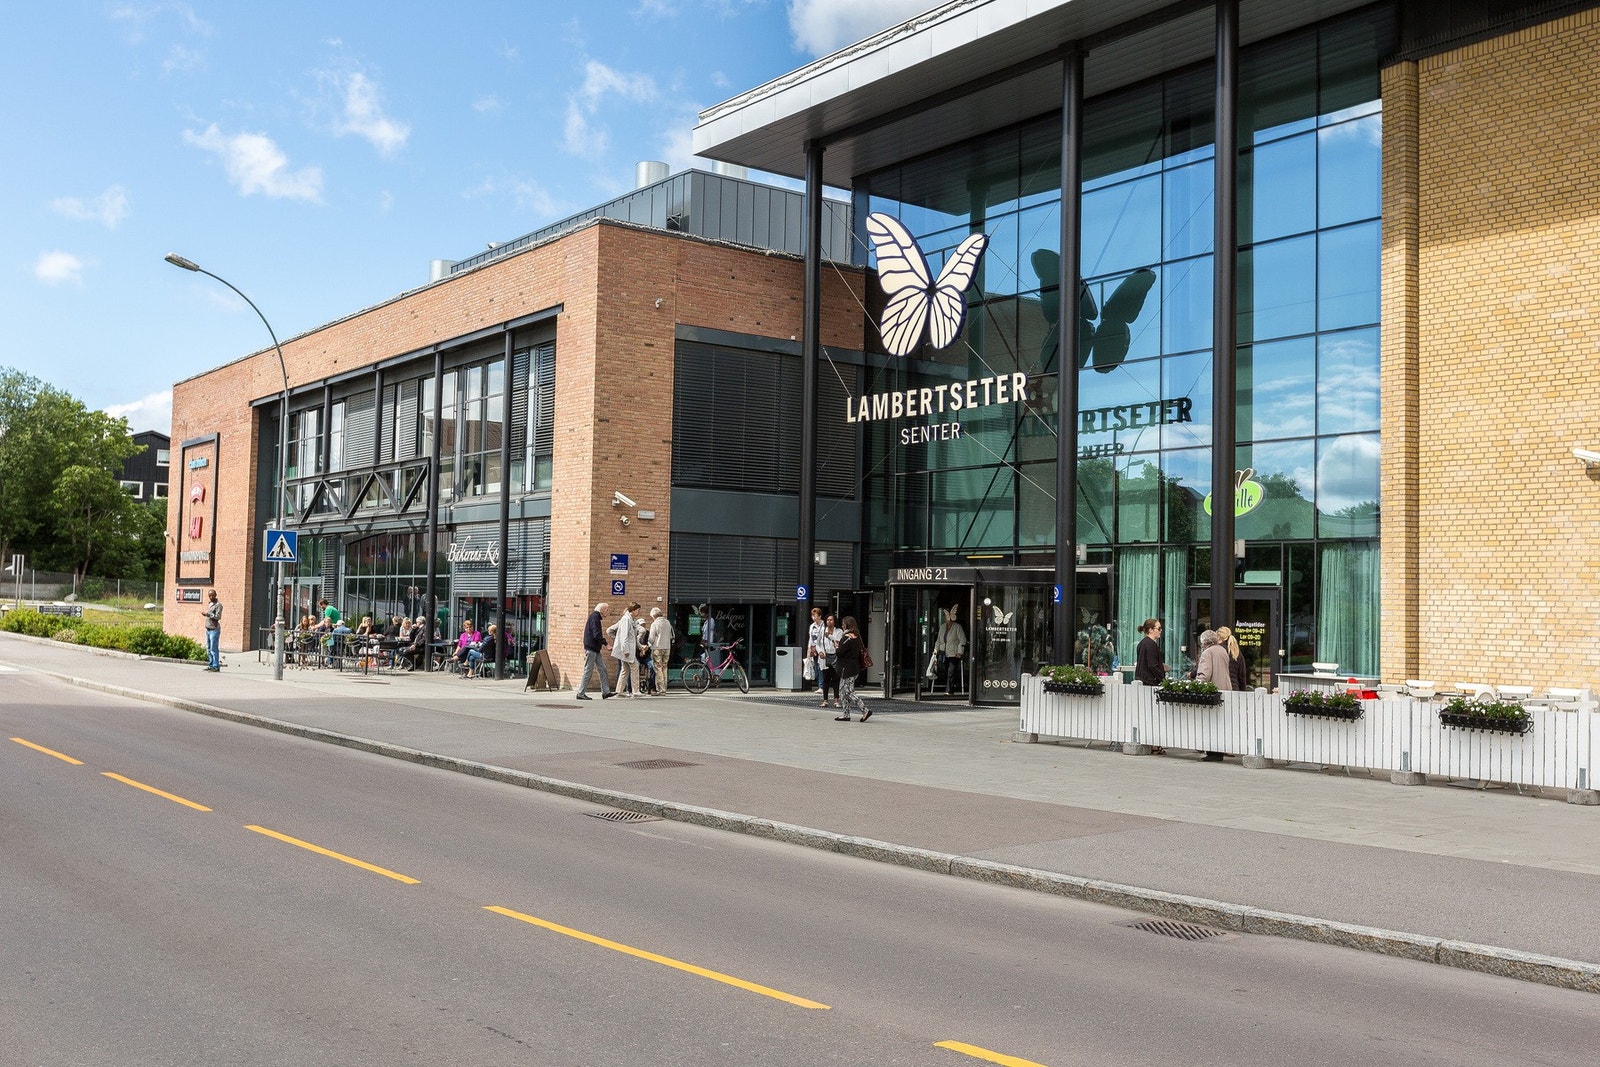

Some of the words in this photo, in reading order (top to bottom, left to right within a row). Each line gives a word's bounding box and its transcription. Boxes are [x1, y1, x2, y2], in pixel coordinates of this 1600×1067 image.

[846, 372, 1028, 424] LAMBERTSETER
[901, 422, 961, 446] SENTER
[897, 568, 932, 580] INNGANG
[935, 568, 948, 580] 21
[1235, 620, 1265, 628] Åpningstider
